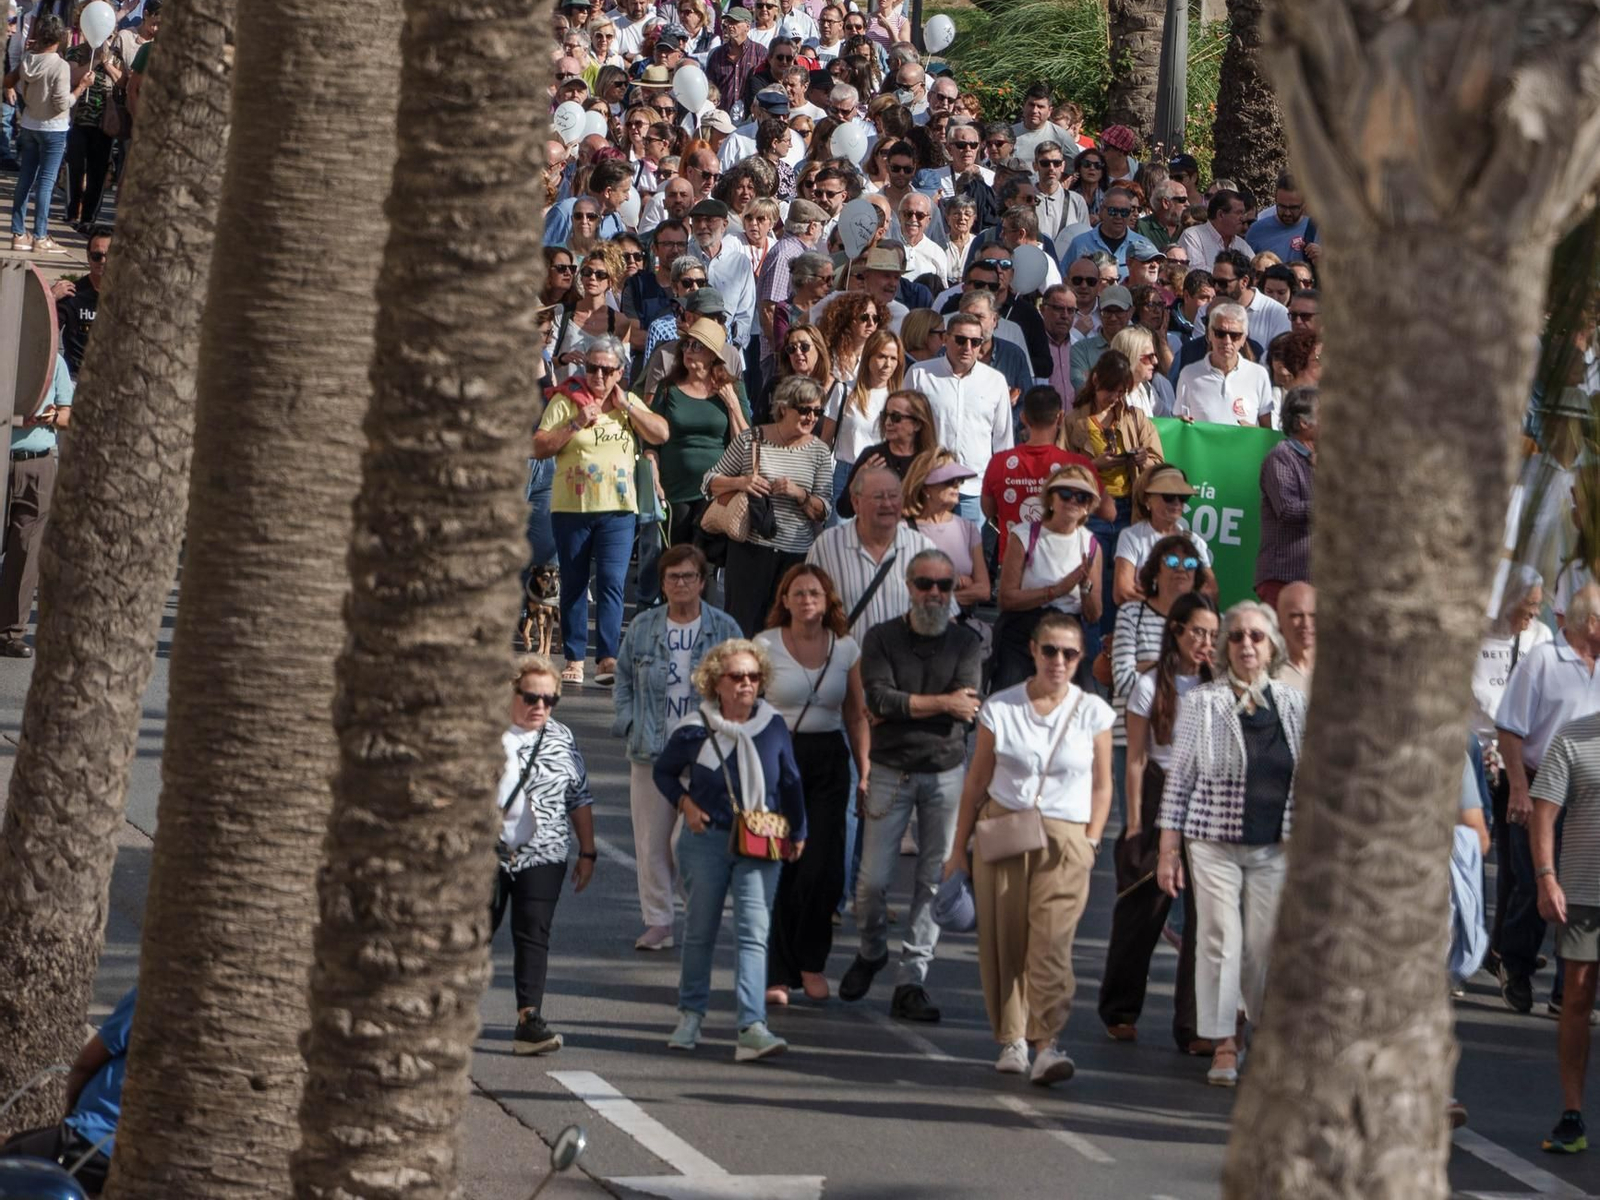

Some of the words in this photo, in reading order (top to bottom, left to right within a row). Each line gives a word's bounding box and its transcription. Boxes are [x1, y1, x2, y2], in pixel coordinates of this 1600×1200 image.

[593, 426, 630, 453] Party
[1004, 477, 1037, 486] Contigo
[665, 696, 691, 718] NT
